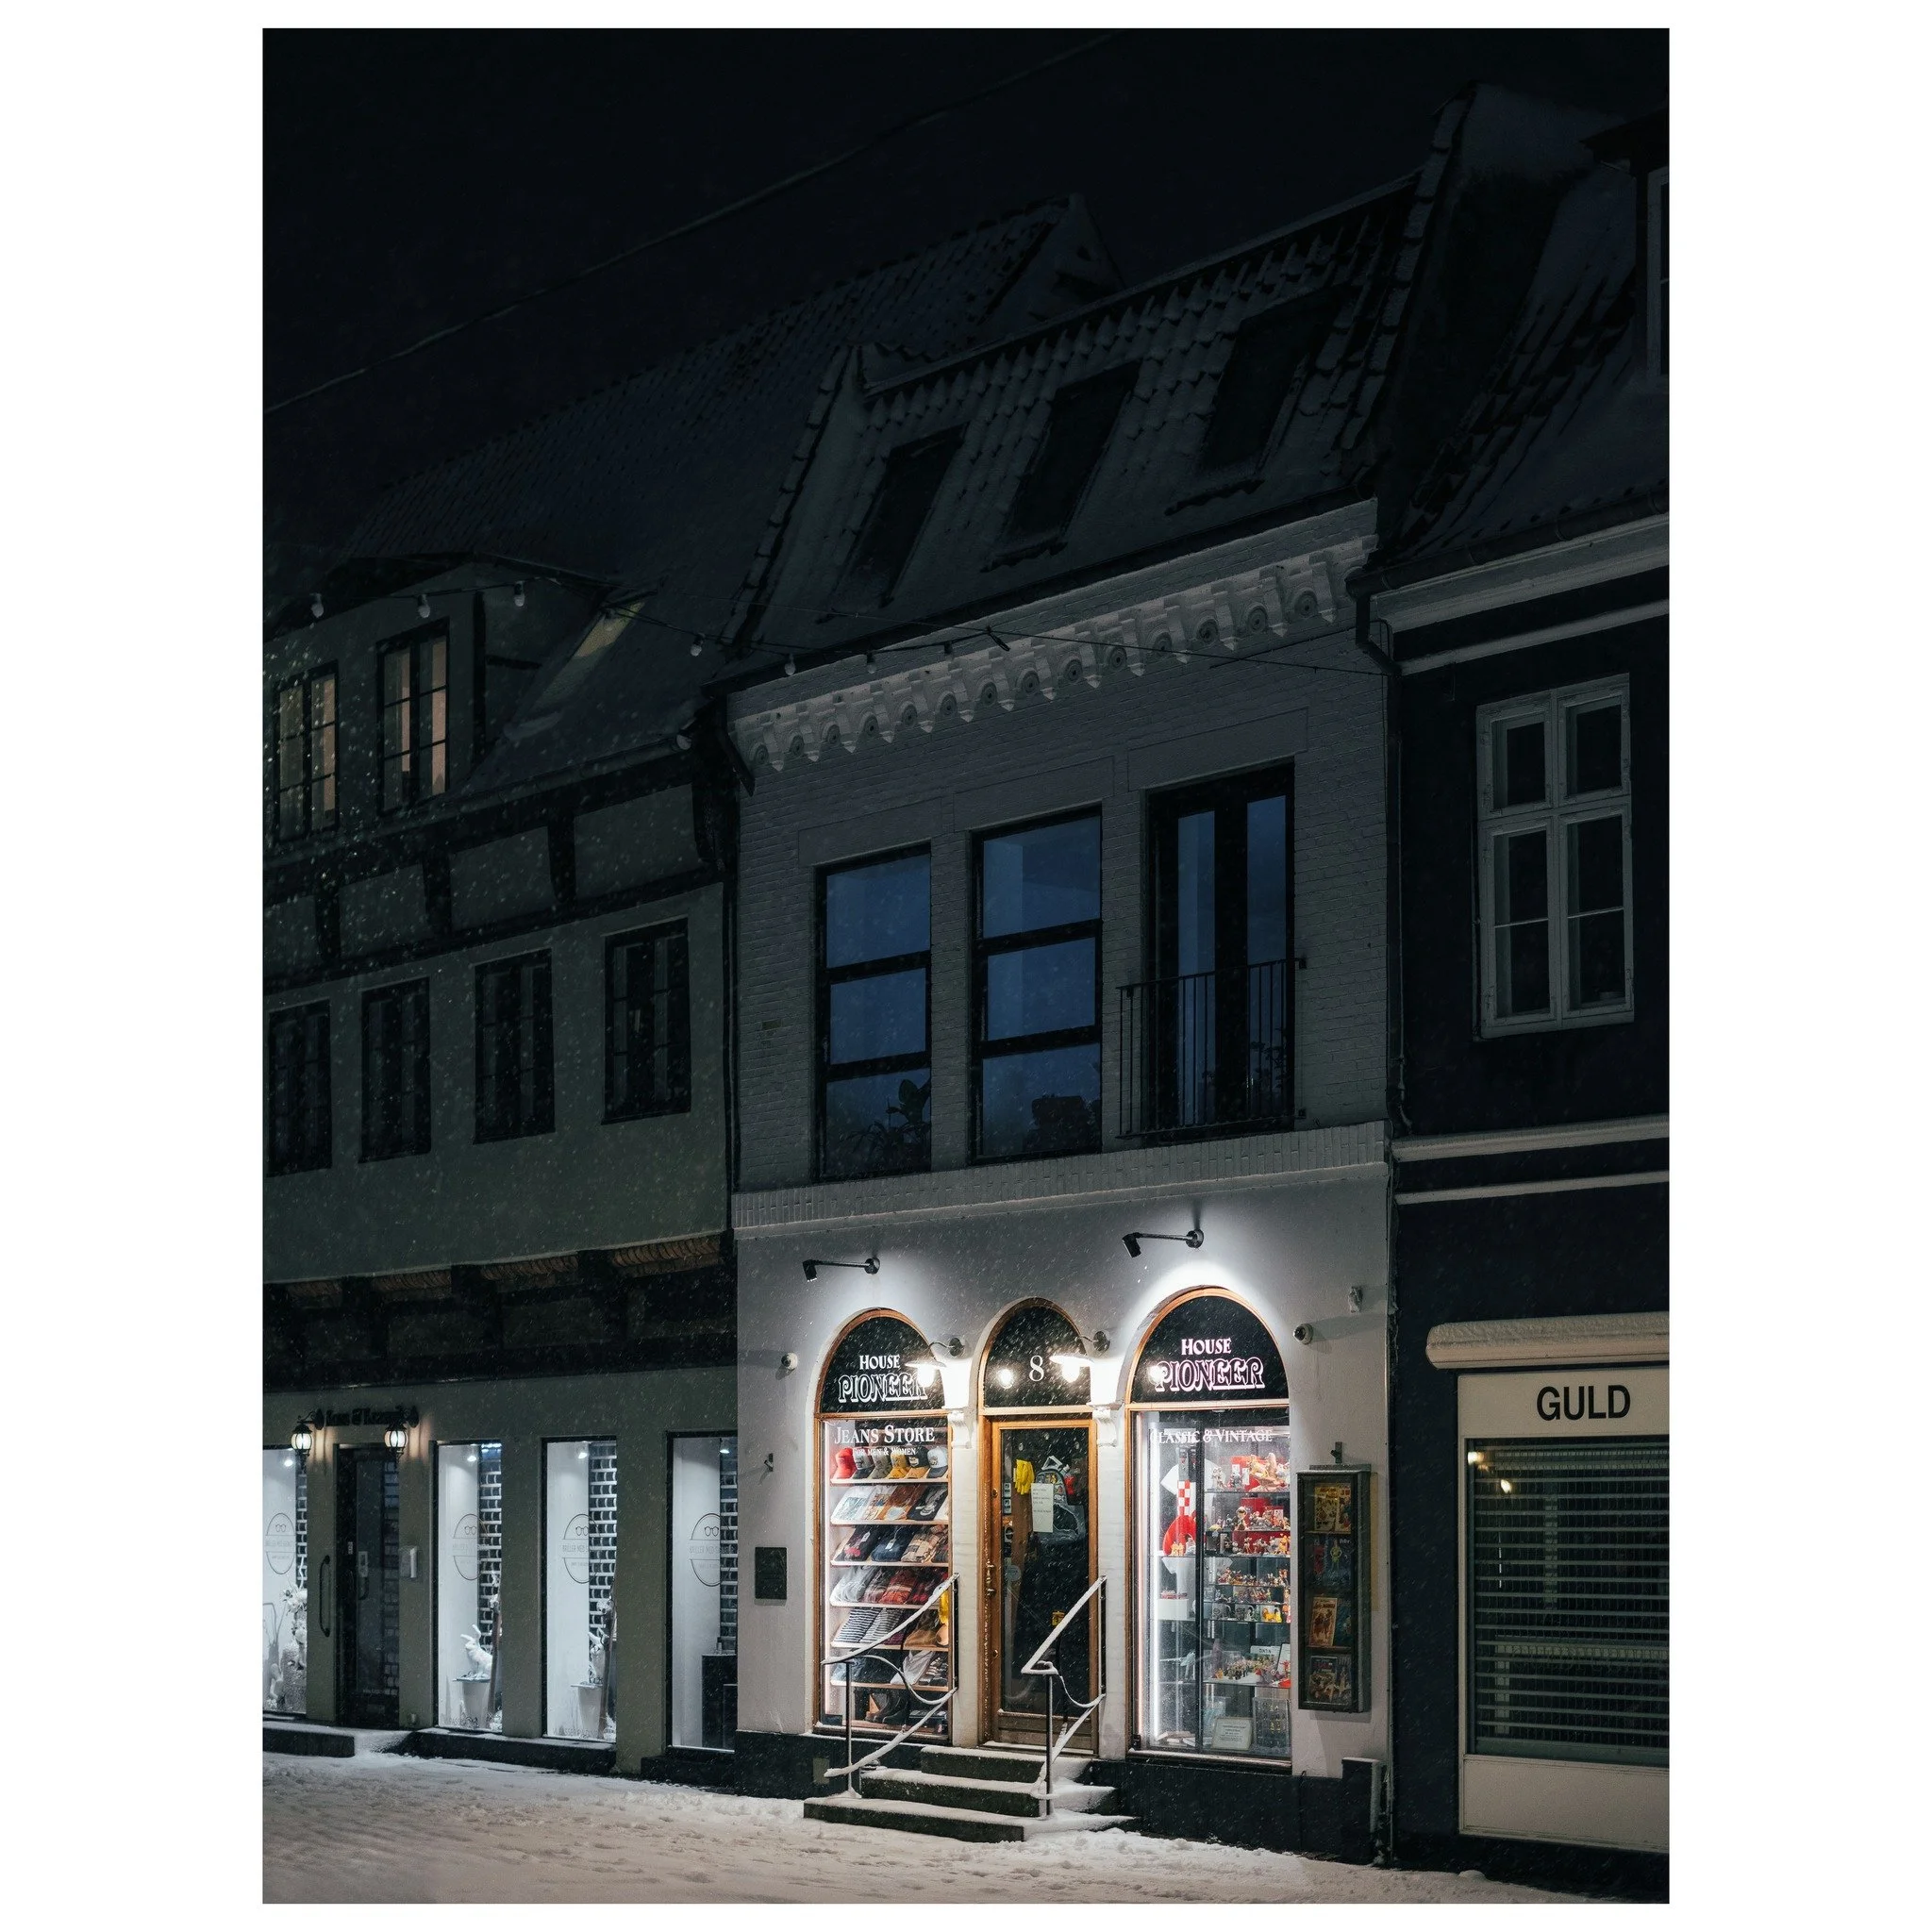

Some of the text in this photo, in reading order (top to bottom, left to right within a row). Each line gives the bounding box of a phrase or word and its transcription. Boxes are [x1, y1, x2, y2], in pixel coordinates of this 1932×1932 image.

[1181, 1338, 1232, 1356] HOUSE
[859, 1354, 901, 1370] HOUSE
[1028, 1355, 1044, 1382] 8
[1154, 1357, 1266, 1392] PIONEER
[1536, 1384, 1631, 1421] GULD
[834, 1424, 936, 1444] JEANS STORE
[1149, 1428, 1274, 1444] CLASSIC & VINTAGE
[883, 1446, 889, 1456] &
